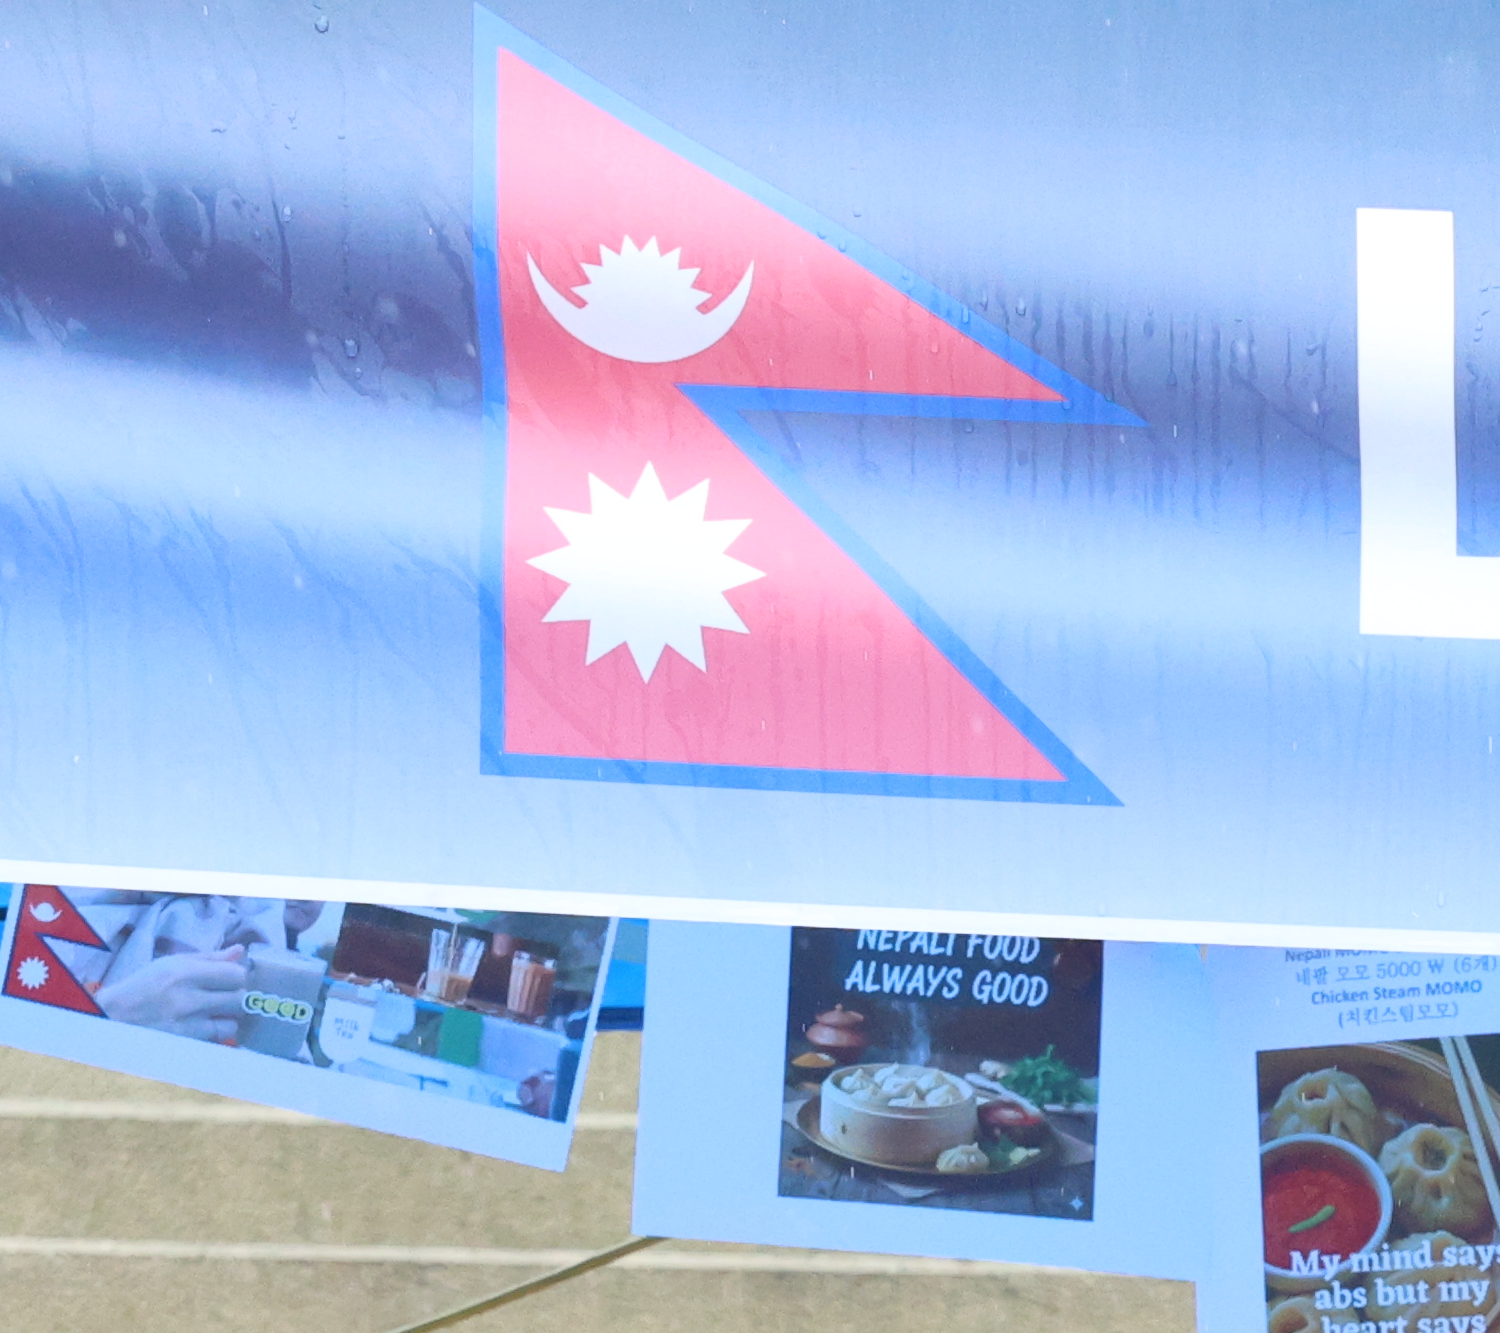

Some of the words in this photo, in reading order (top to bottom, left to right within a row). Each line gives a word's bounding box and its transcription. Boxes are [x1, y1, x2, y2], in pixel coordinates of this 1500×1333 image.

[857, 929, 956, 957] NEPALI
[967, 934, 1041, 964] FOOD
[844, 959, 963, 999] ALWAYS
[972, 969, 1049, 1007] GOOD
[1376, 961, 1421, 979] 5000
[245, 992, 312, 1022] GOOD
[1311, 989, 1369, 1005] Chicken
[1373, 984, 1422, 1000] Steam
[1426, 979, 1483, 996] MOMO
[1290, 1249, 1342, 1281] My
[1350, 1240, 1434, 1273] mind
[1314, 1280, 1368, 1311] abs
[1374, 1276, 1430, 1306] but
[1437, 1279, 1491, 1307] my
